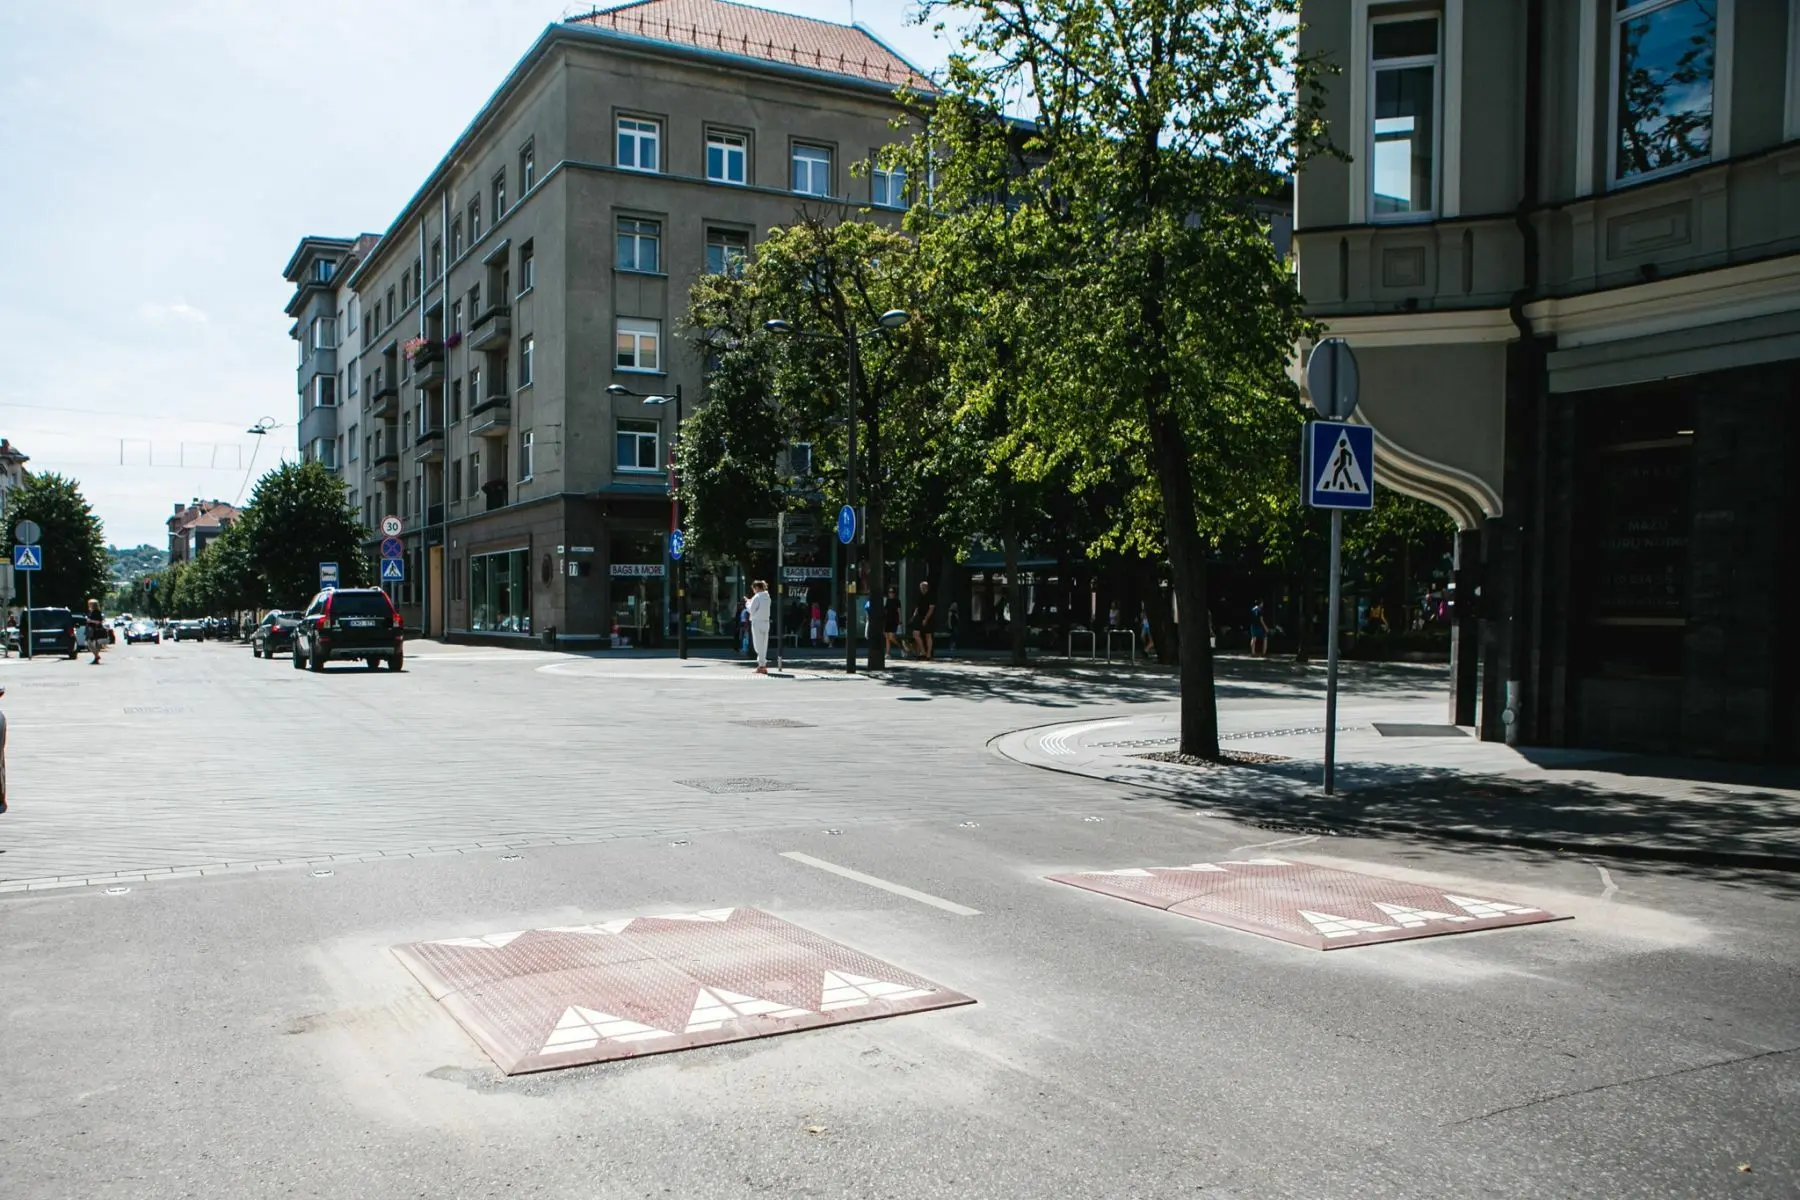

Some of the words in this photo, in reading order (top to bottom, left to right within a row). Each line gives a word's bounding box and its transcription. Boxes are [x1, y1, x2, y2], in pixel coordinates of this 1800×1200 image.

[386, 523, 398, 531] 30
[569, 563, 578, 575] 77
[612, 565, 632, 575] BAGS
[634, 565, 640, 575] &
[641, 565, 663, 575] MORE
[785, 567, 804, 577] BAGS
[806, 567, 811, 577] &
[811, 567, 831, 577] MORE
